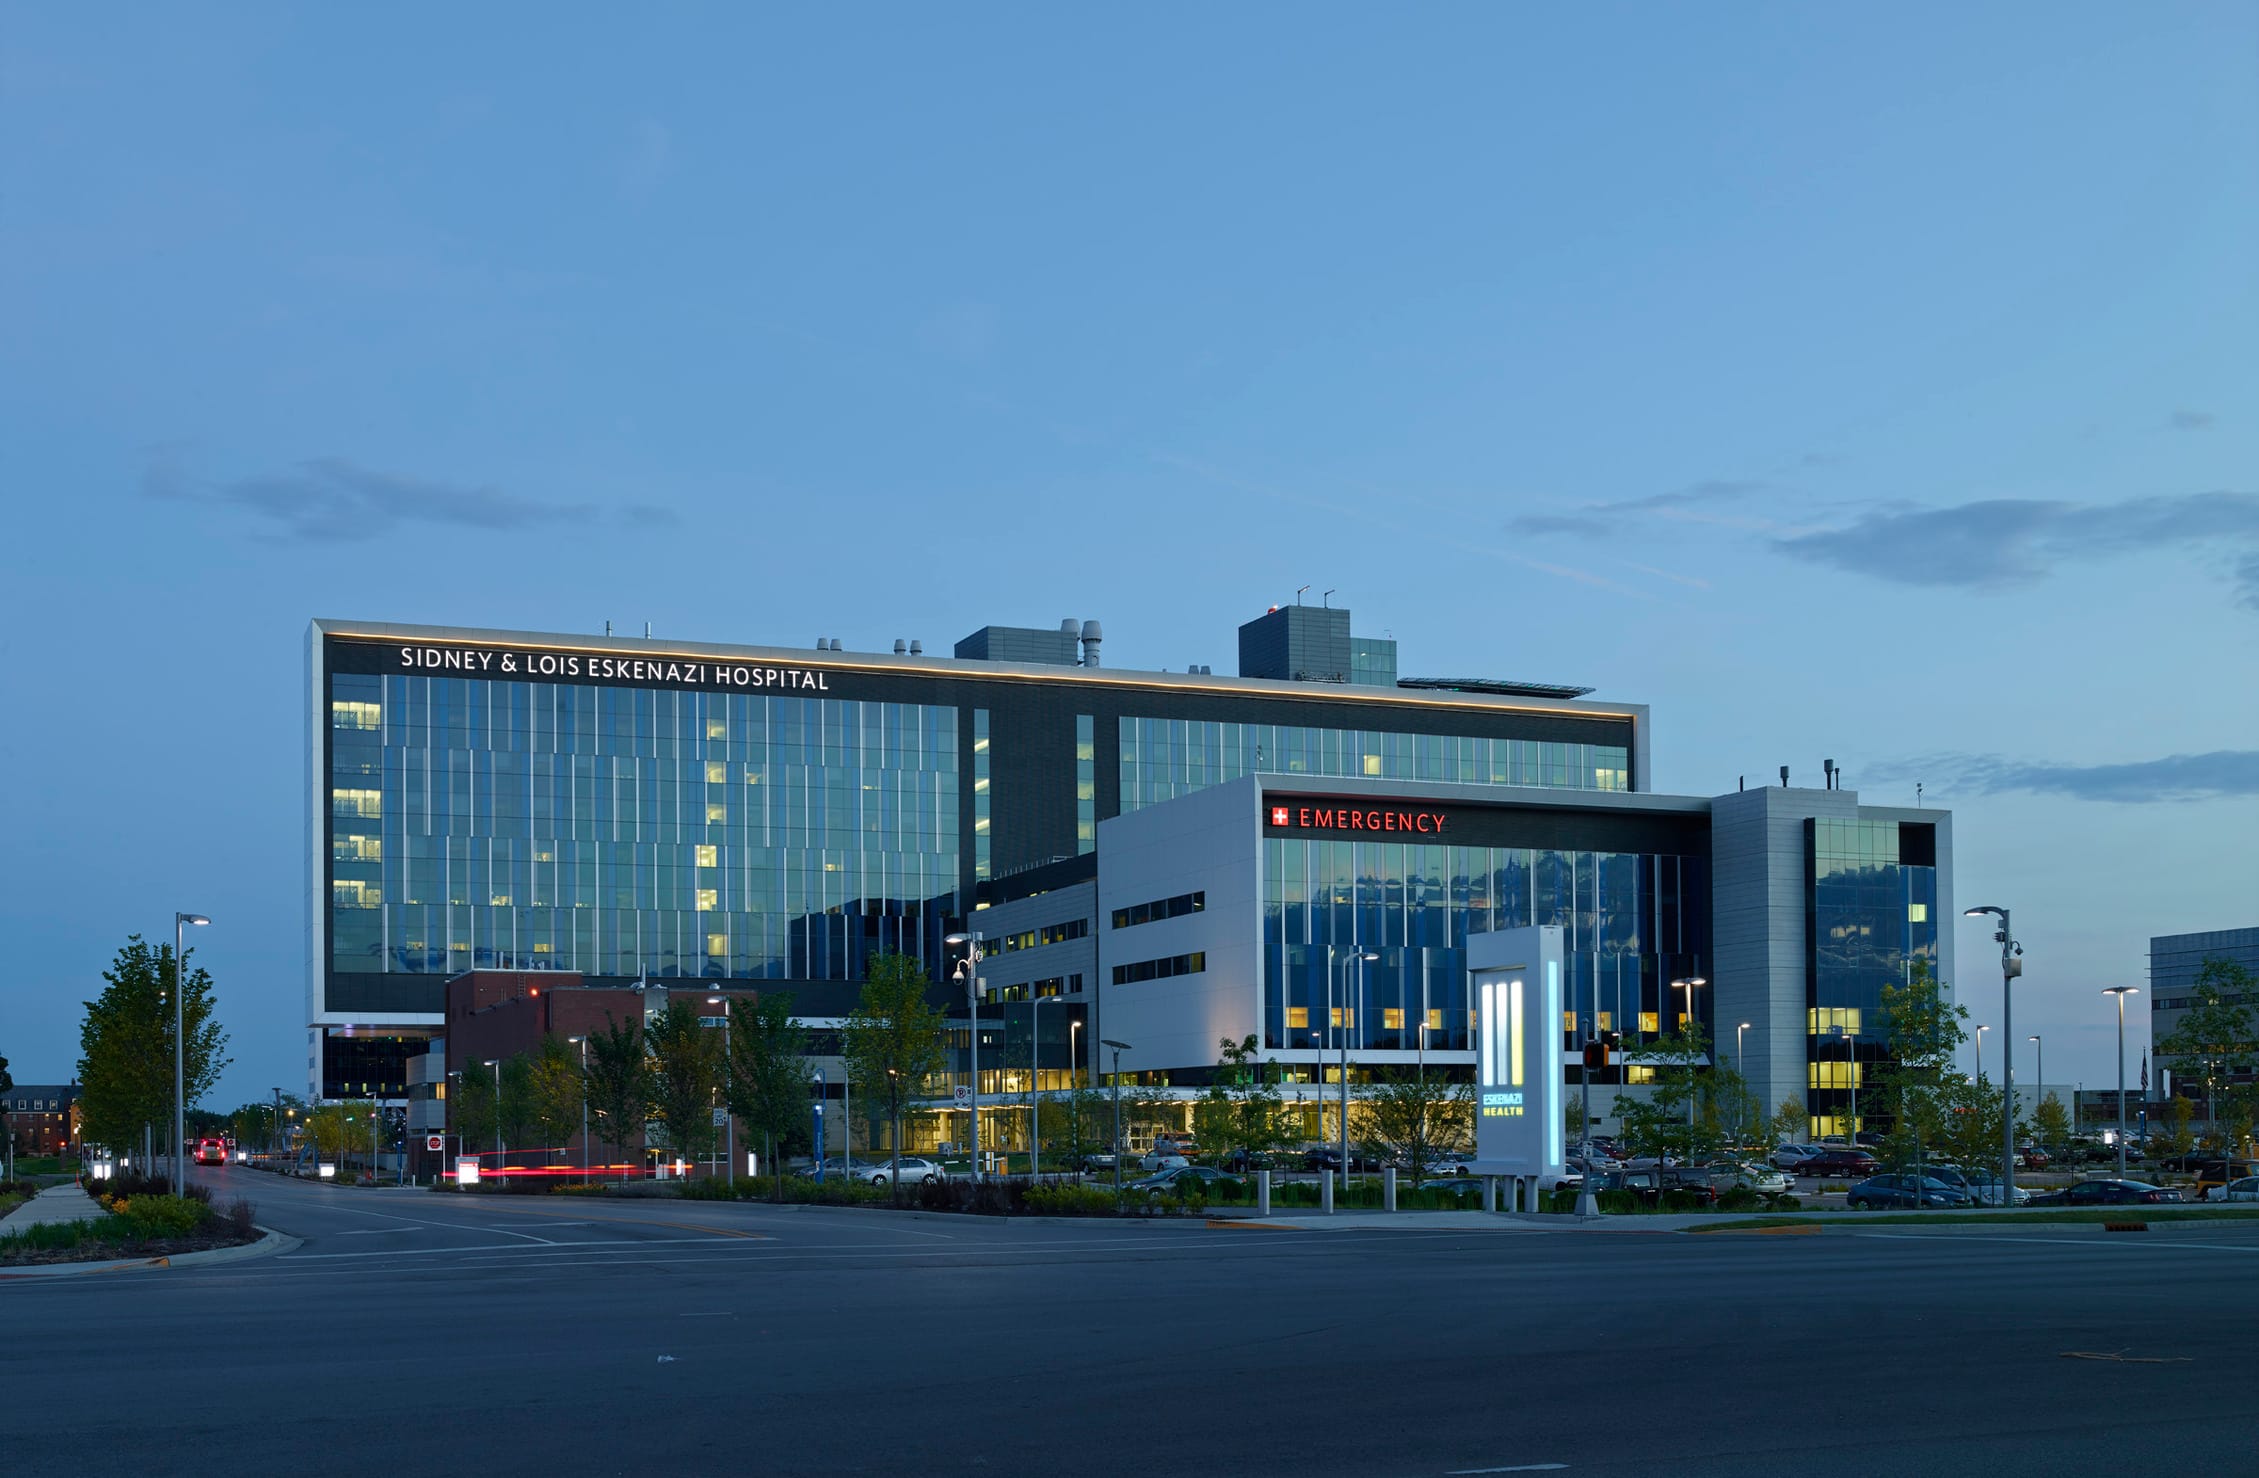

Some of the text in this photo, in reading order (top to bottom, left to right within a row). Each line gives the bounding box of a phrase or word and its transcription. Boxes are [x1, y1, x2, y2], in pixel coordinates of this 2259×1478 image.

[401, 647, 829, 690] SIDNEY & LOIS ESKENAZI HOSPITAL
[1300, 808, 1445, 833] EMERGENCY
[1482, 1106, 1524, 1117] HEALTH
